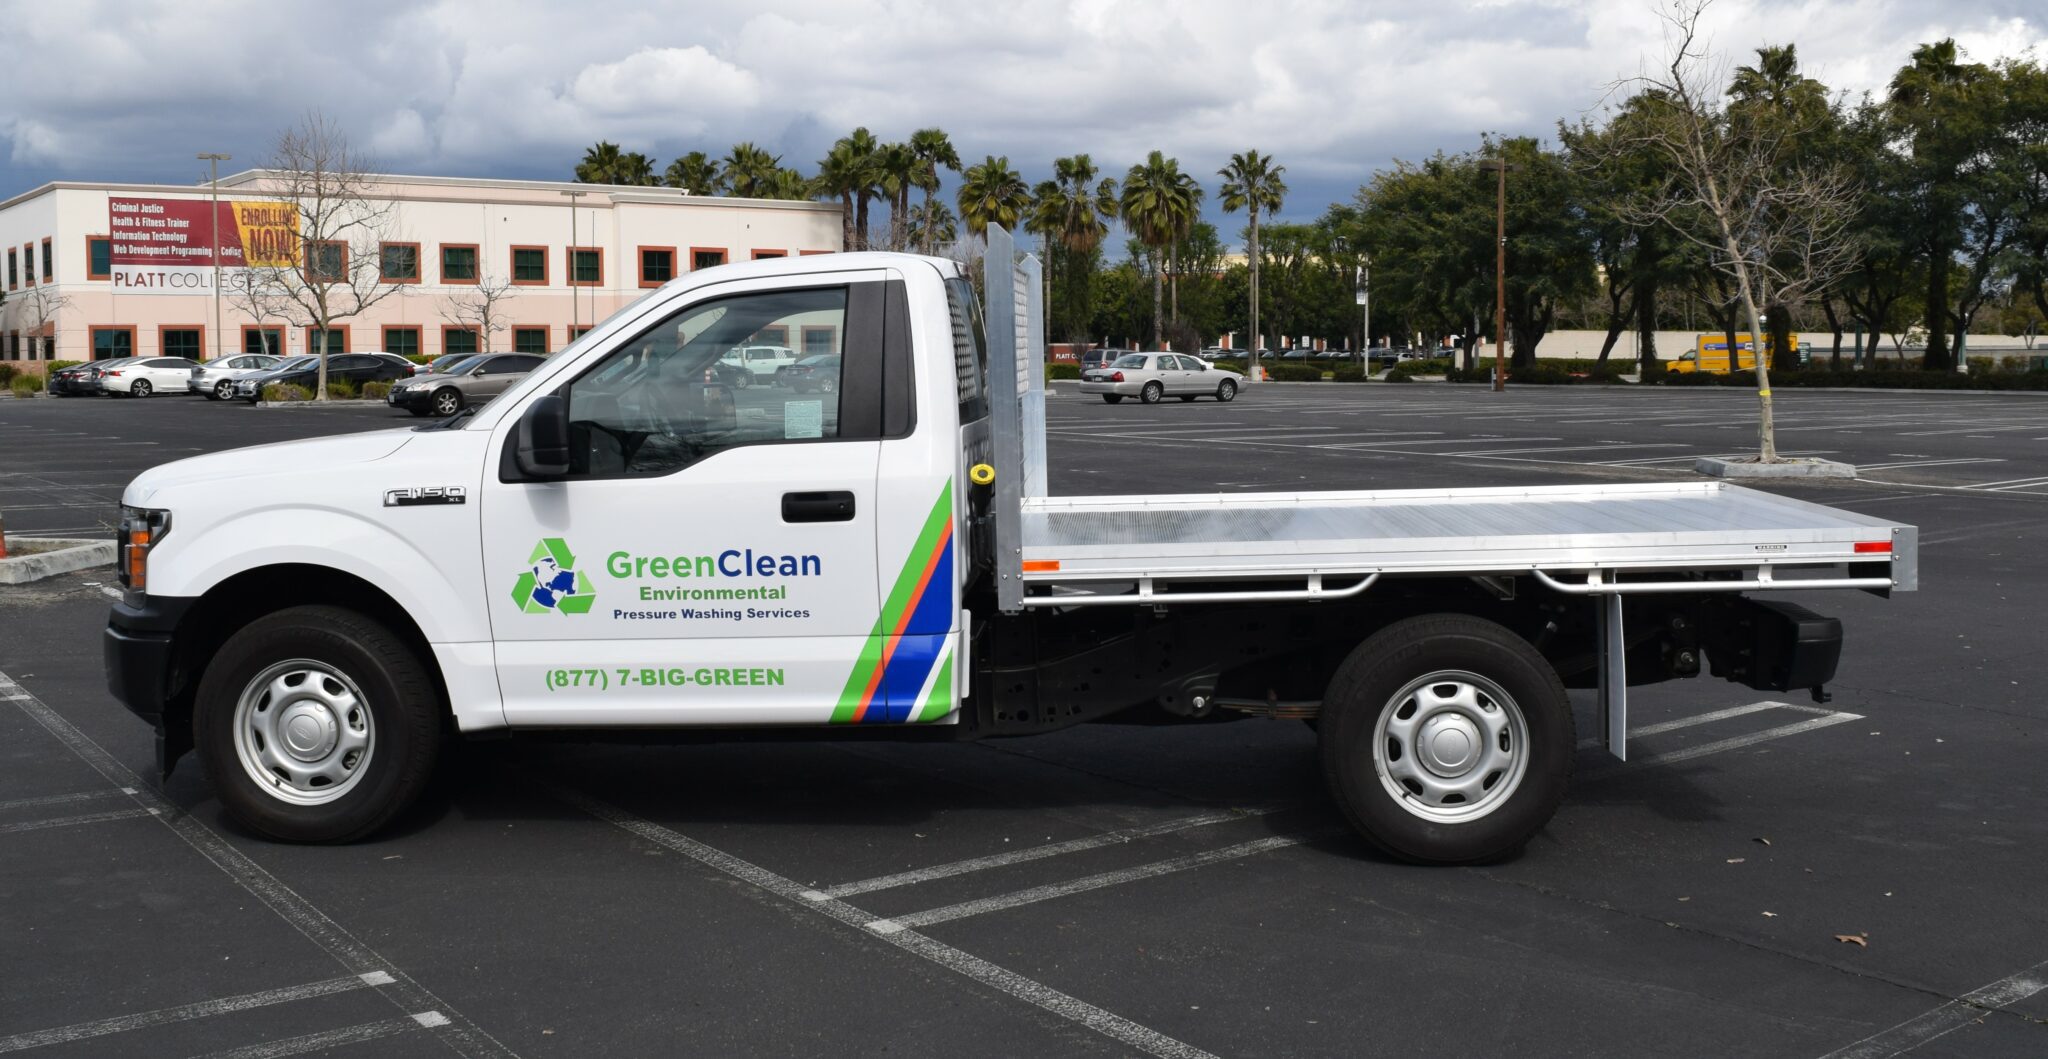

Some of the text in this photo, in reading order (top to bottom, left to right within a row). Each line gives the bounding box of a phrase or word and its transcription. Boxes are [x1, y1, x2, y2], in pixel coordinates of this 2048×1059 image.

[112, 203, 164, 214] Criminal Justice
[112, 217, 189, 228] Health & Fitness Trainer
[241, 207, 297, 227] ENROLLING
[113, 231, 187, 243] Information Technology
[113, 245, 127, 254] Web
[128, 246, 170, 257] Development
[171, 246, 212, 257] Programming
[220, 246, 242, 257] Coding
[114, 272, 166, 288] PLATT
[639, 585, 786, 601] Environmental
[613, 607, 811, 621] Pressure Washing Services
[545, 668, 785, 691] (877) 7-BIG-GREEN
